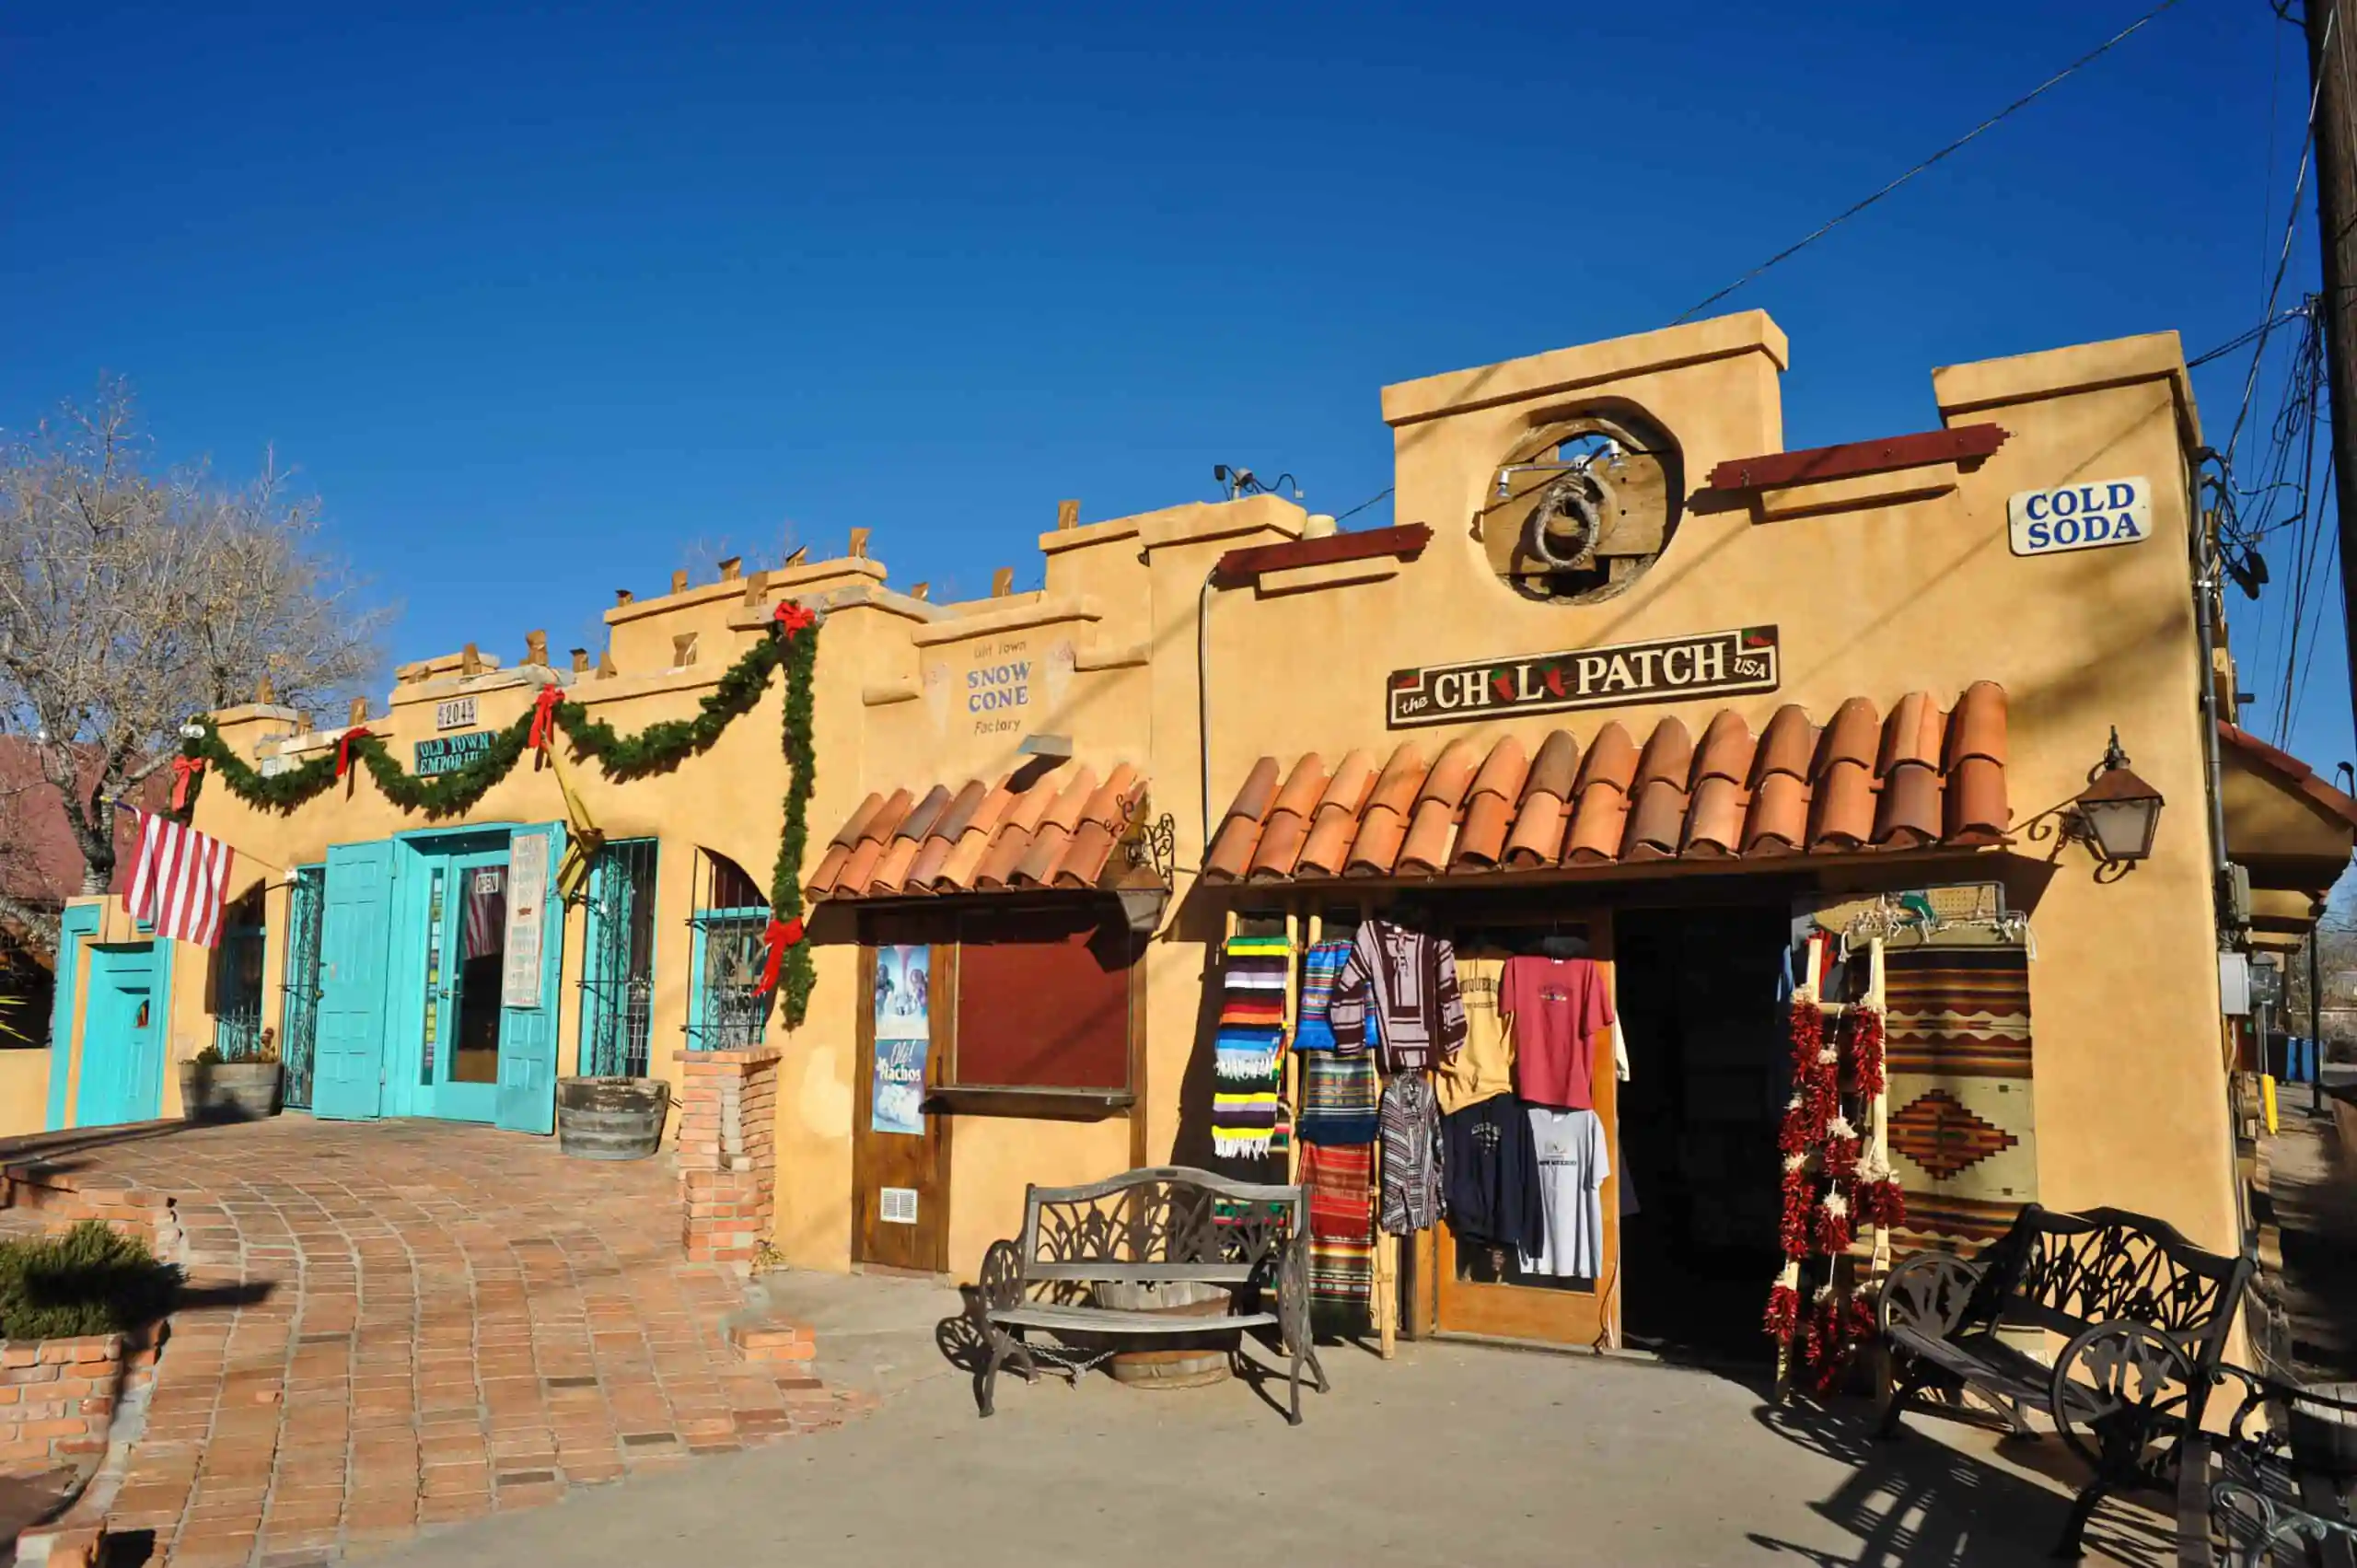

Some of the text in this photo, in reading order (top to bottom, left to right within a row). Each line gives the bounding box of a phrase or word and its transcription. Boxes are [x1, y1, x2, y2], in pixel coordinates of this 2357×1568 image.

[2026, 483, 2135, 520] COLD
[2028, 512, 2141, 549] SODA
[967, 660, 1032, 689] SNOW
[1399, 696, 1428, 714] the
[1575, 641, 1727, 694] PATCH
[1733, 657, 1767, 679] USA
[969, 686, 1029, 713] CONE
[974, 718, 1021, 736] Factory
[420, 732, 490, 757] OLD TOWN
